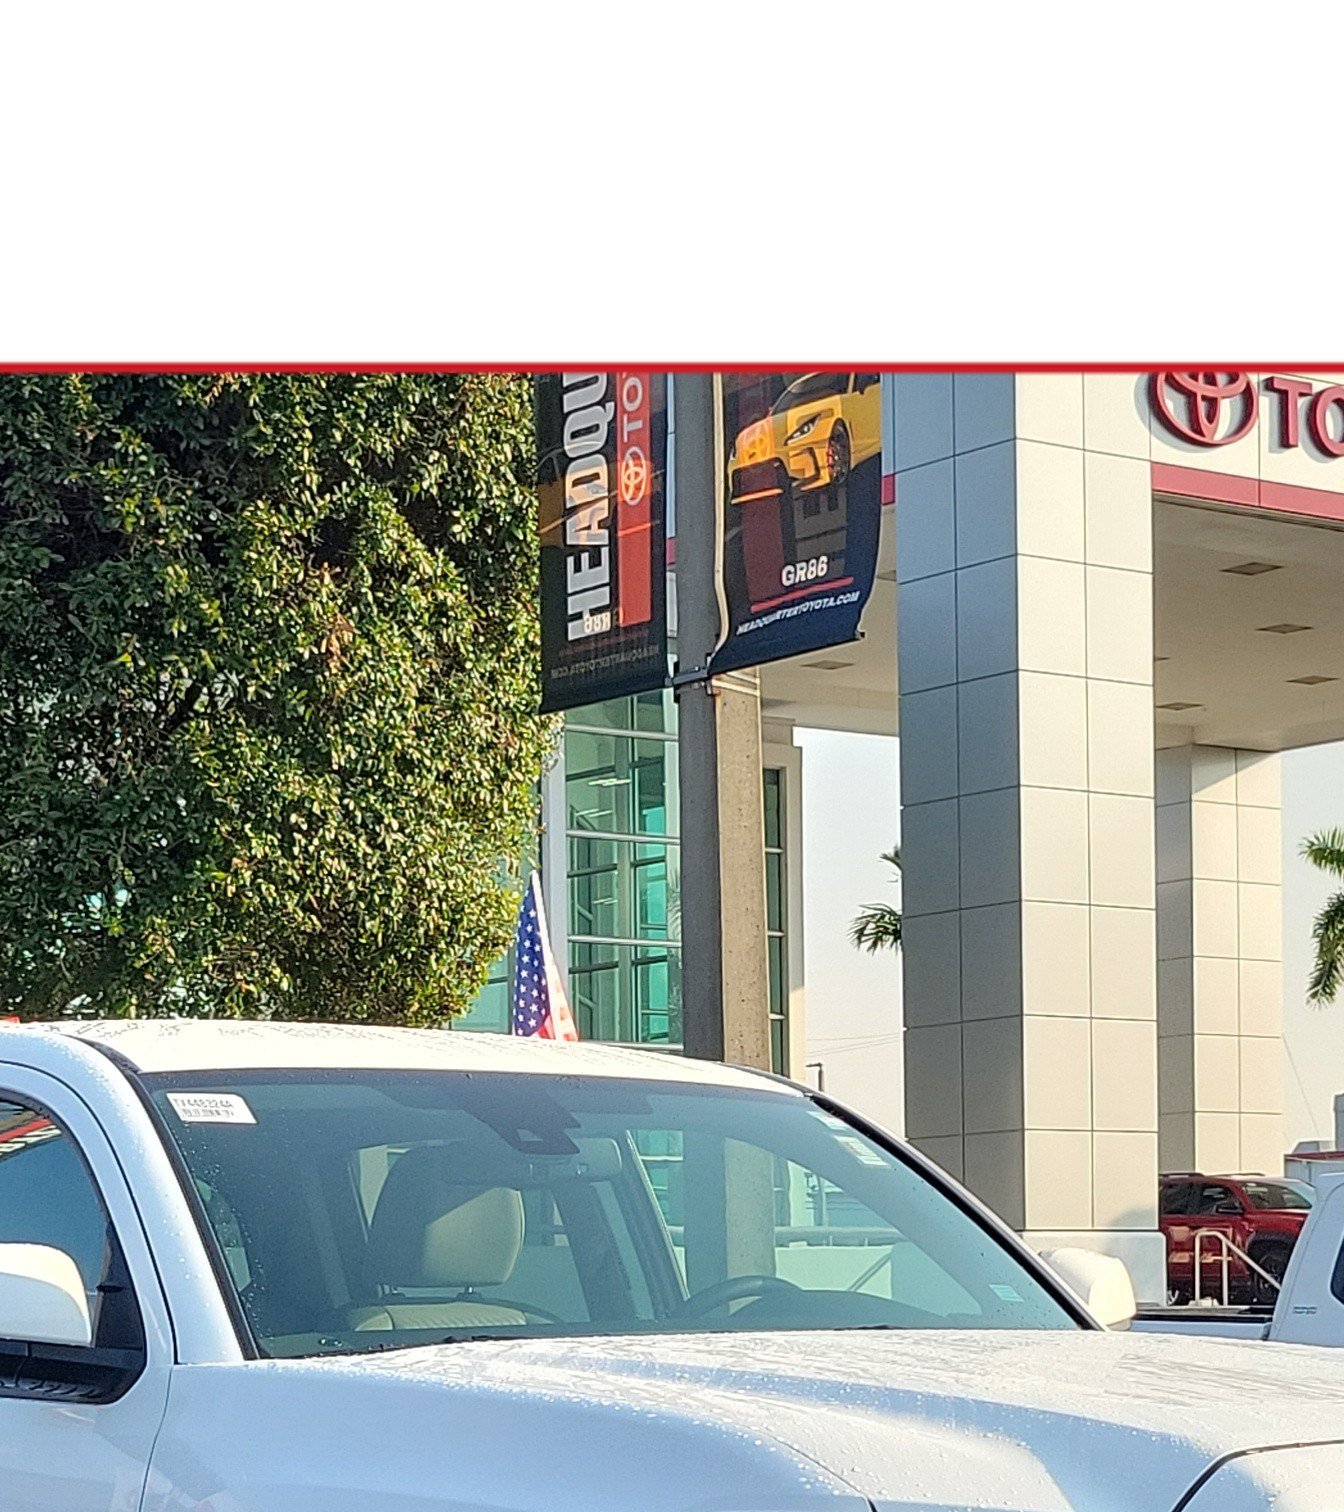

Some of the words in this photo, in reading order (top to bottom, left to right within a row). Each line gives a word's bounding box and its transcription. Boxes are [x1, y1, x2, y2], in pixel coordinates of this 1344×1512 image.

[622, 372, 644, 443] TO
[781, 555, 828, 587] GR86
[736, 591, 860, 635] HEADQUARTERTOYOTA.COM
